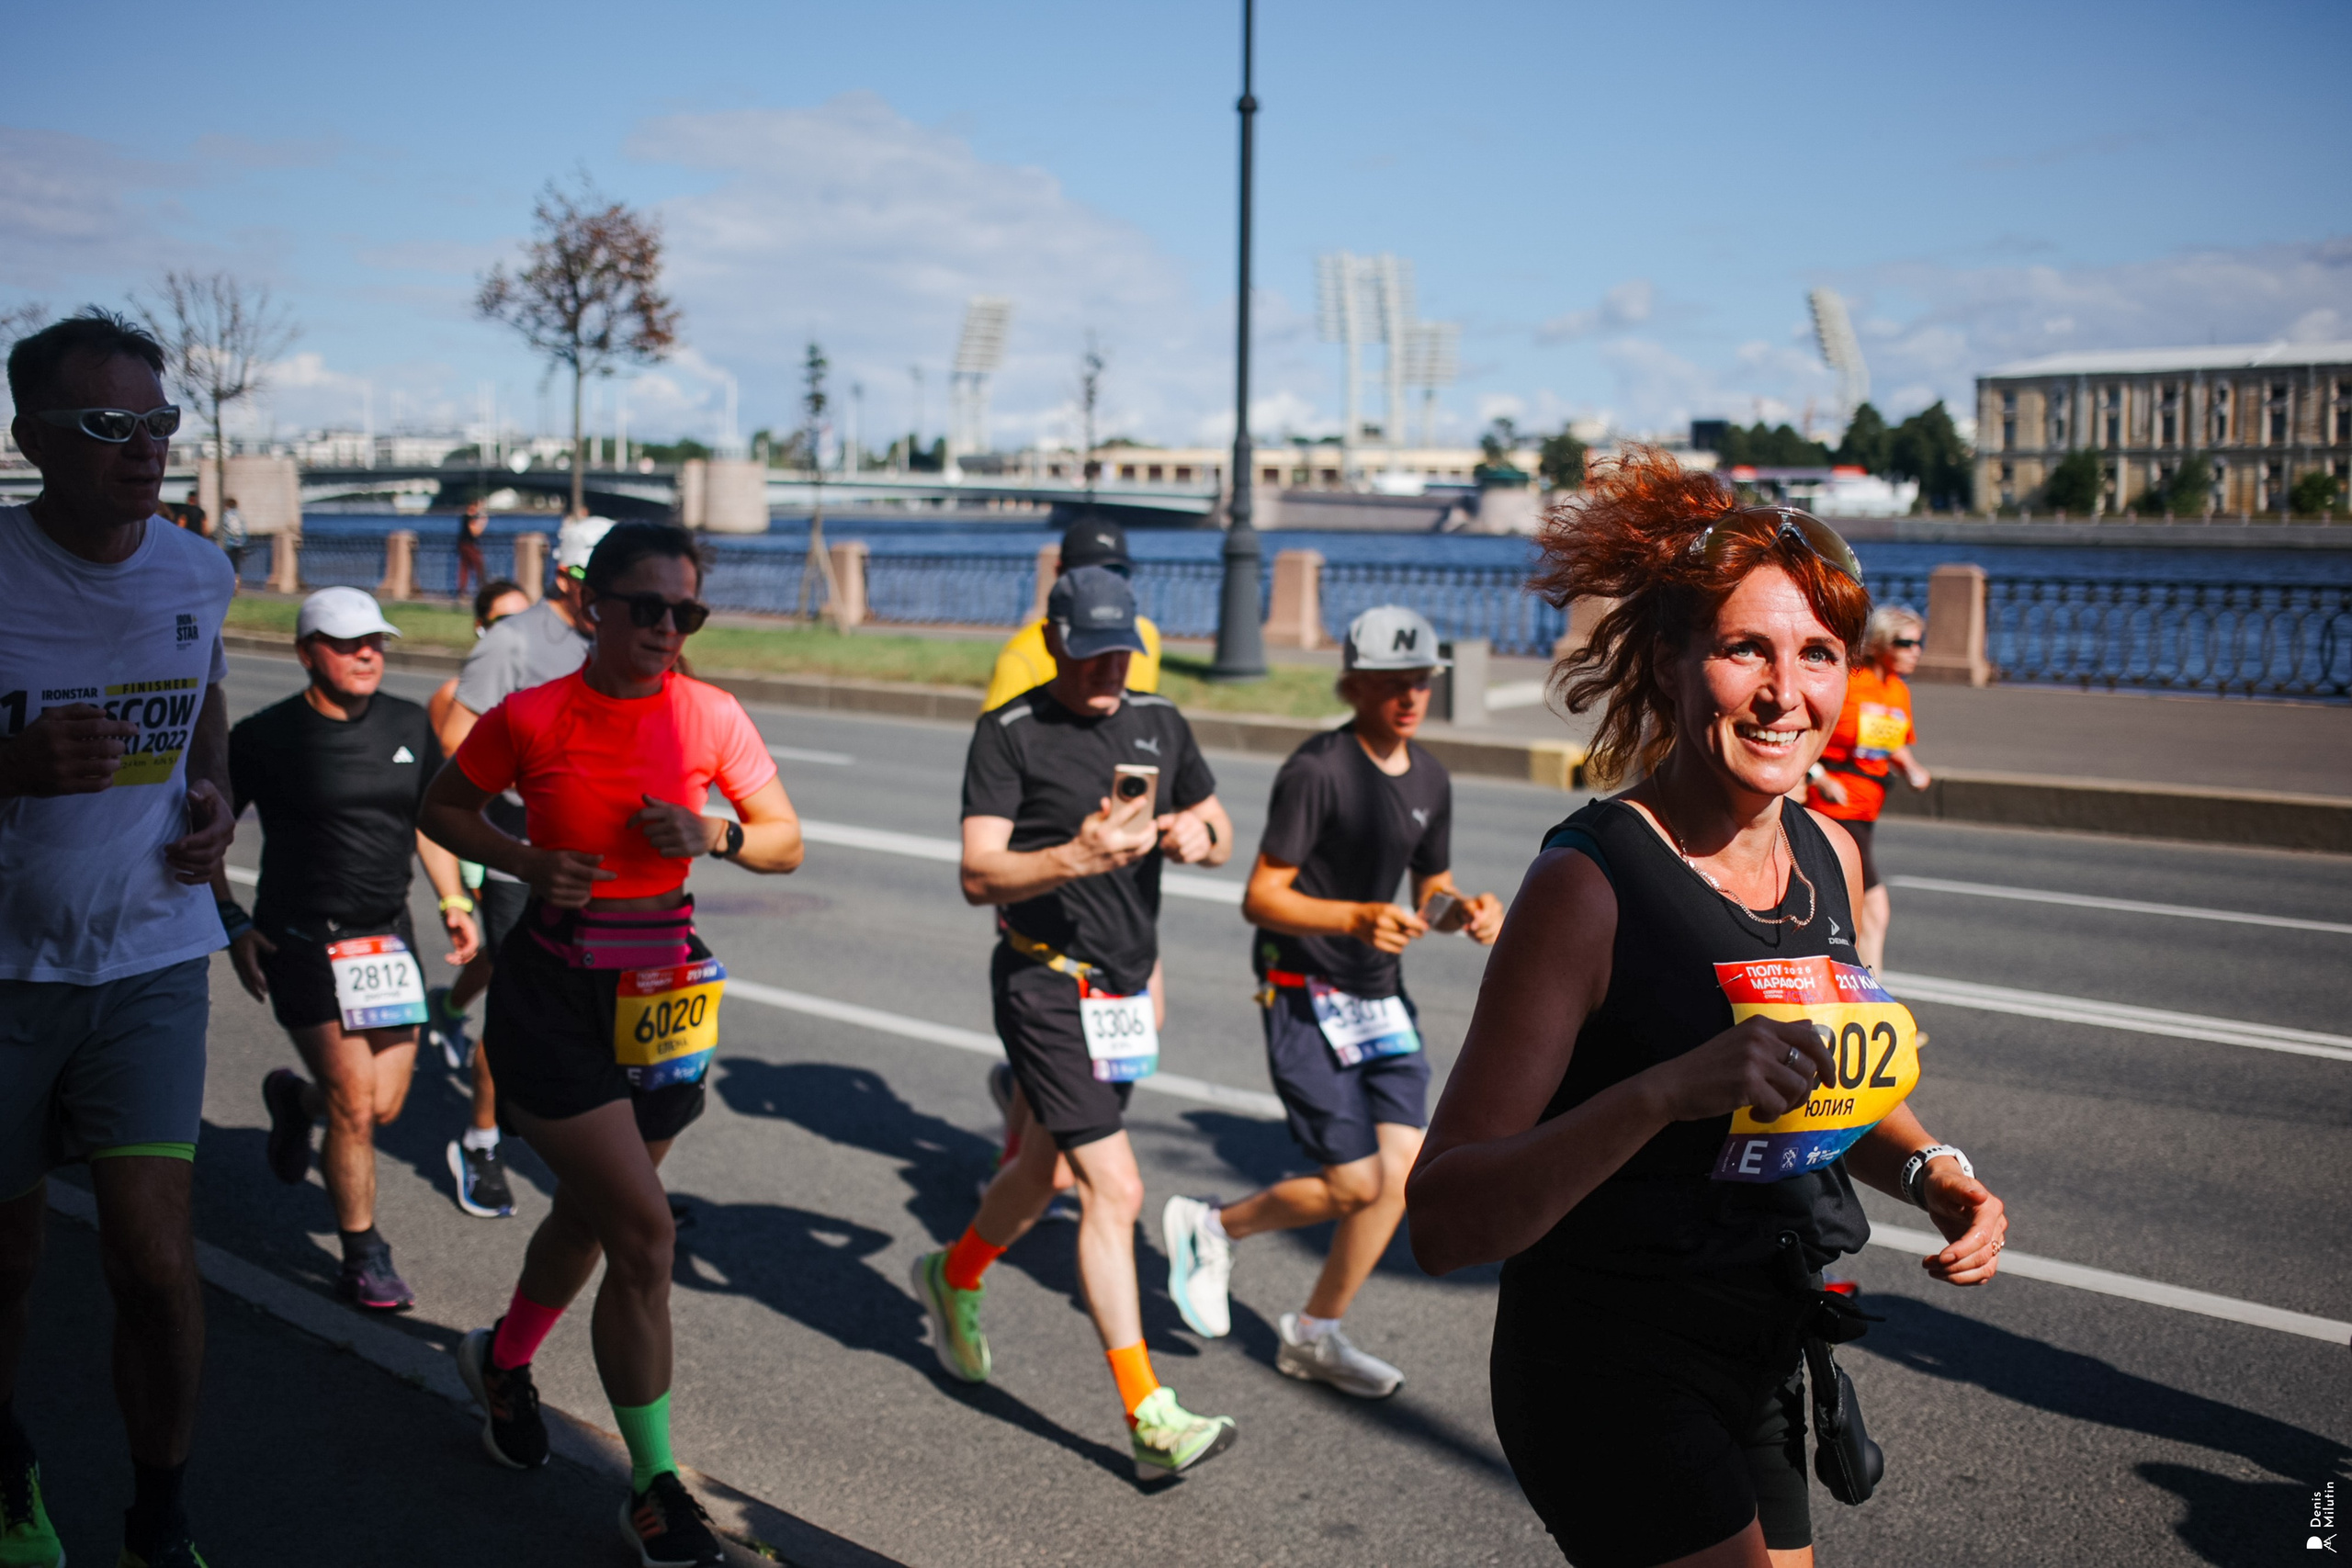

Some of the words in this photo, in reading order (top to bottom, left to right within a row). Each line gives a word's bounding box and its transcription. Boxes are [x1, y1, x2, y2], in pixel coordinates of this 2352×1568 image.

[176, 626, 199, 642] STAR
[1393, 628, 1417, 651] N
[41, 687, 98, 701] IRONSTAR
[122, 679, 188, 694] FINISHER
[141, 729, 187, 753] 2022
[348, 962, 410, 991] 2812
[1746, 964, 1781, 977] ПОЛУ
[1750, 976, 1816, 989] МАРАФОН
[1835, 974, 1860, 991] 21,1
[634, 994, 707, 1043] 6020
[1091, 1008, 1146, 1038] 3306
[1804, 1098, 1854, 1117] ЮЛИЯ
[1738, 1140, 1769, 1174] E
